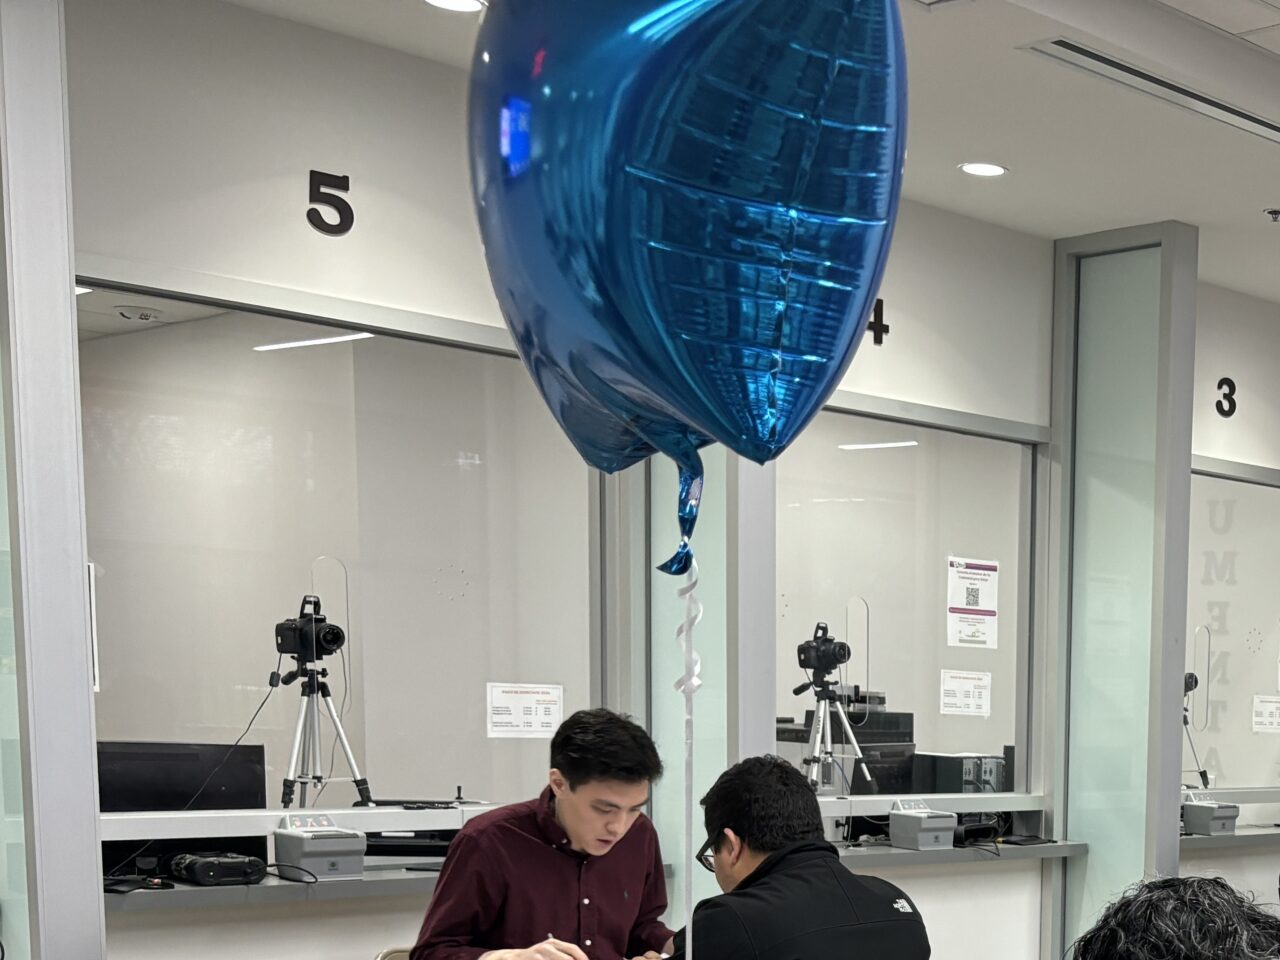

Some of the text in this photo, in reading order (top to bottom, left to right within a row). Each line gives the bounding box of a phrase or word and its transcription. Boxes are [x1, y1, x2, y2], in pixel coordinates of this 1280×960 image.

[306, 169, 354, 236] 5
[866, 298, 890, 347] 4
[1215, 377, 1237, 419] 3
